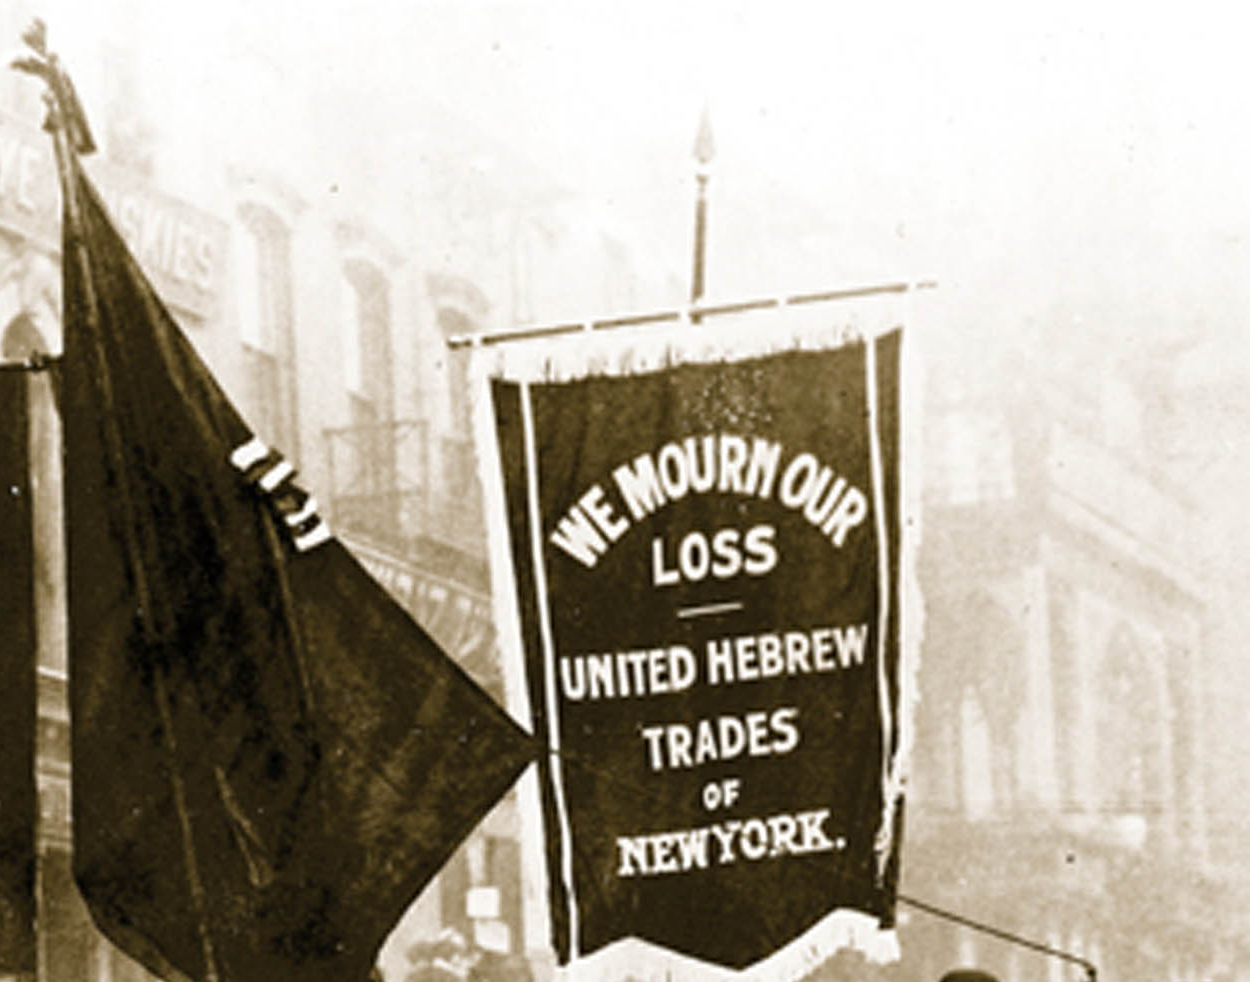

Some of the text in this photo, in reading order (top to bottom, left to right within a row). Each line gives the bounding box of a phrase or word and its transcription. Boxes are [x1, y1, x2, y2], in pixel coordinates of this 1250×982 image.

[550, 434, 868, 567] WE MOURN OUR
[653, 524, 778, 586] LOSS
[562, 624, 869, 699] UNITED HEBREW
[643, 708, 800, 772] TRADES
[703, 779, 740, 811] OF
[617, 829, 710, 877] NEW
